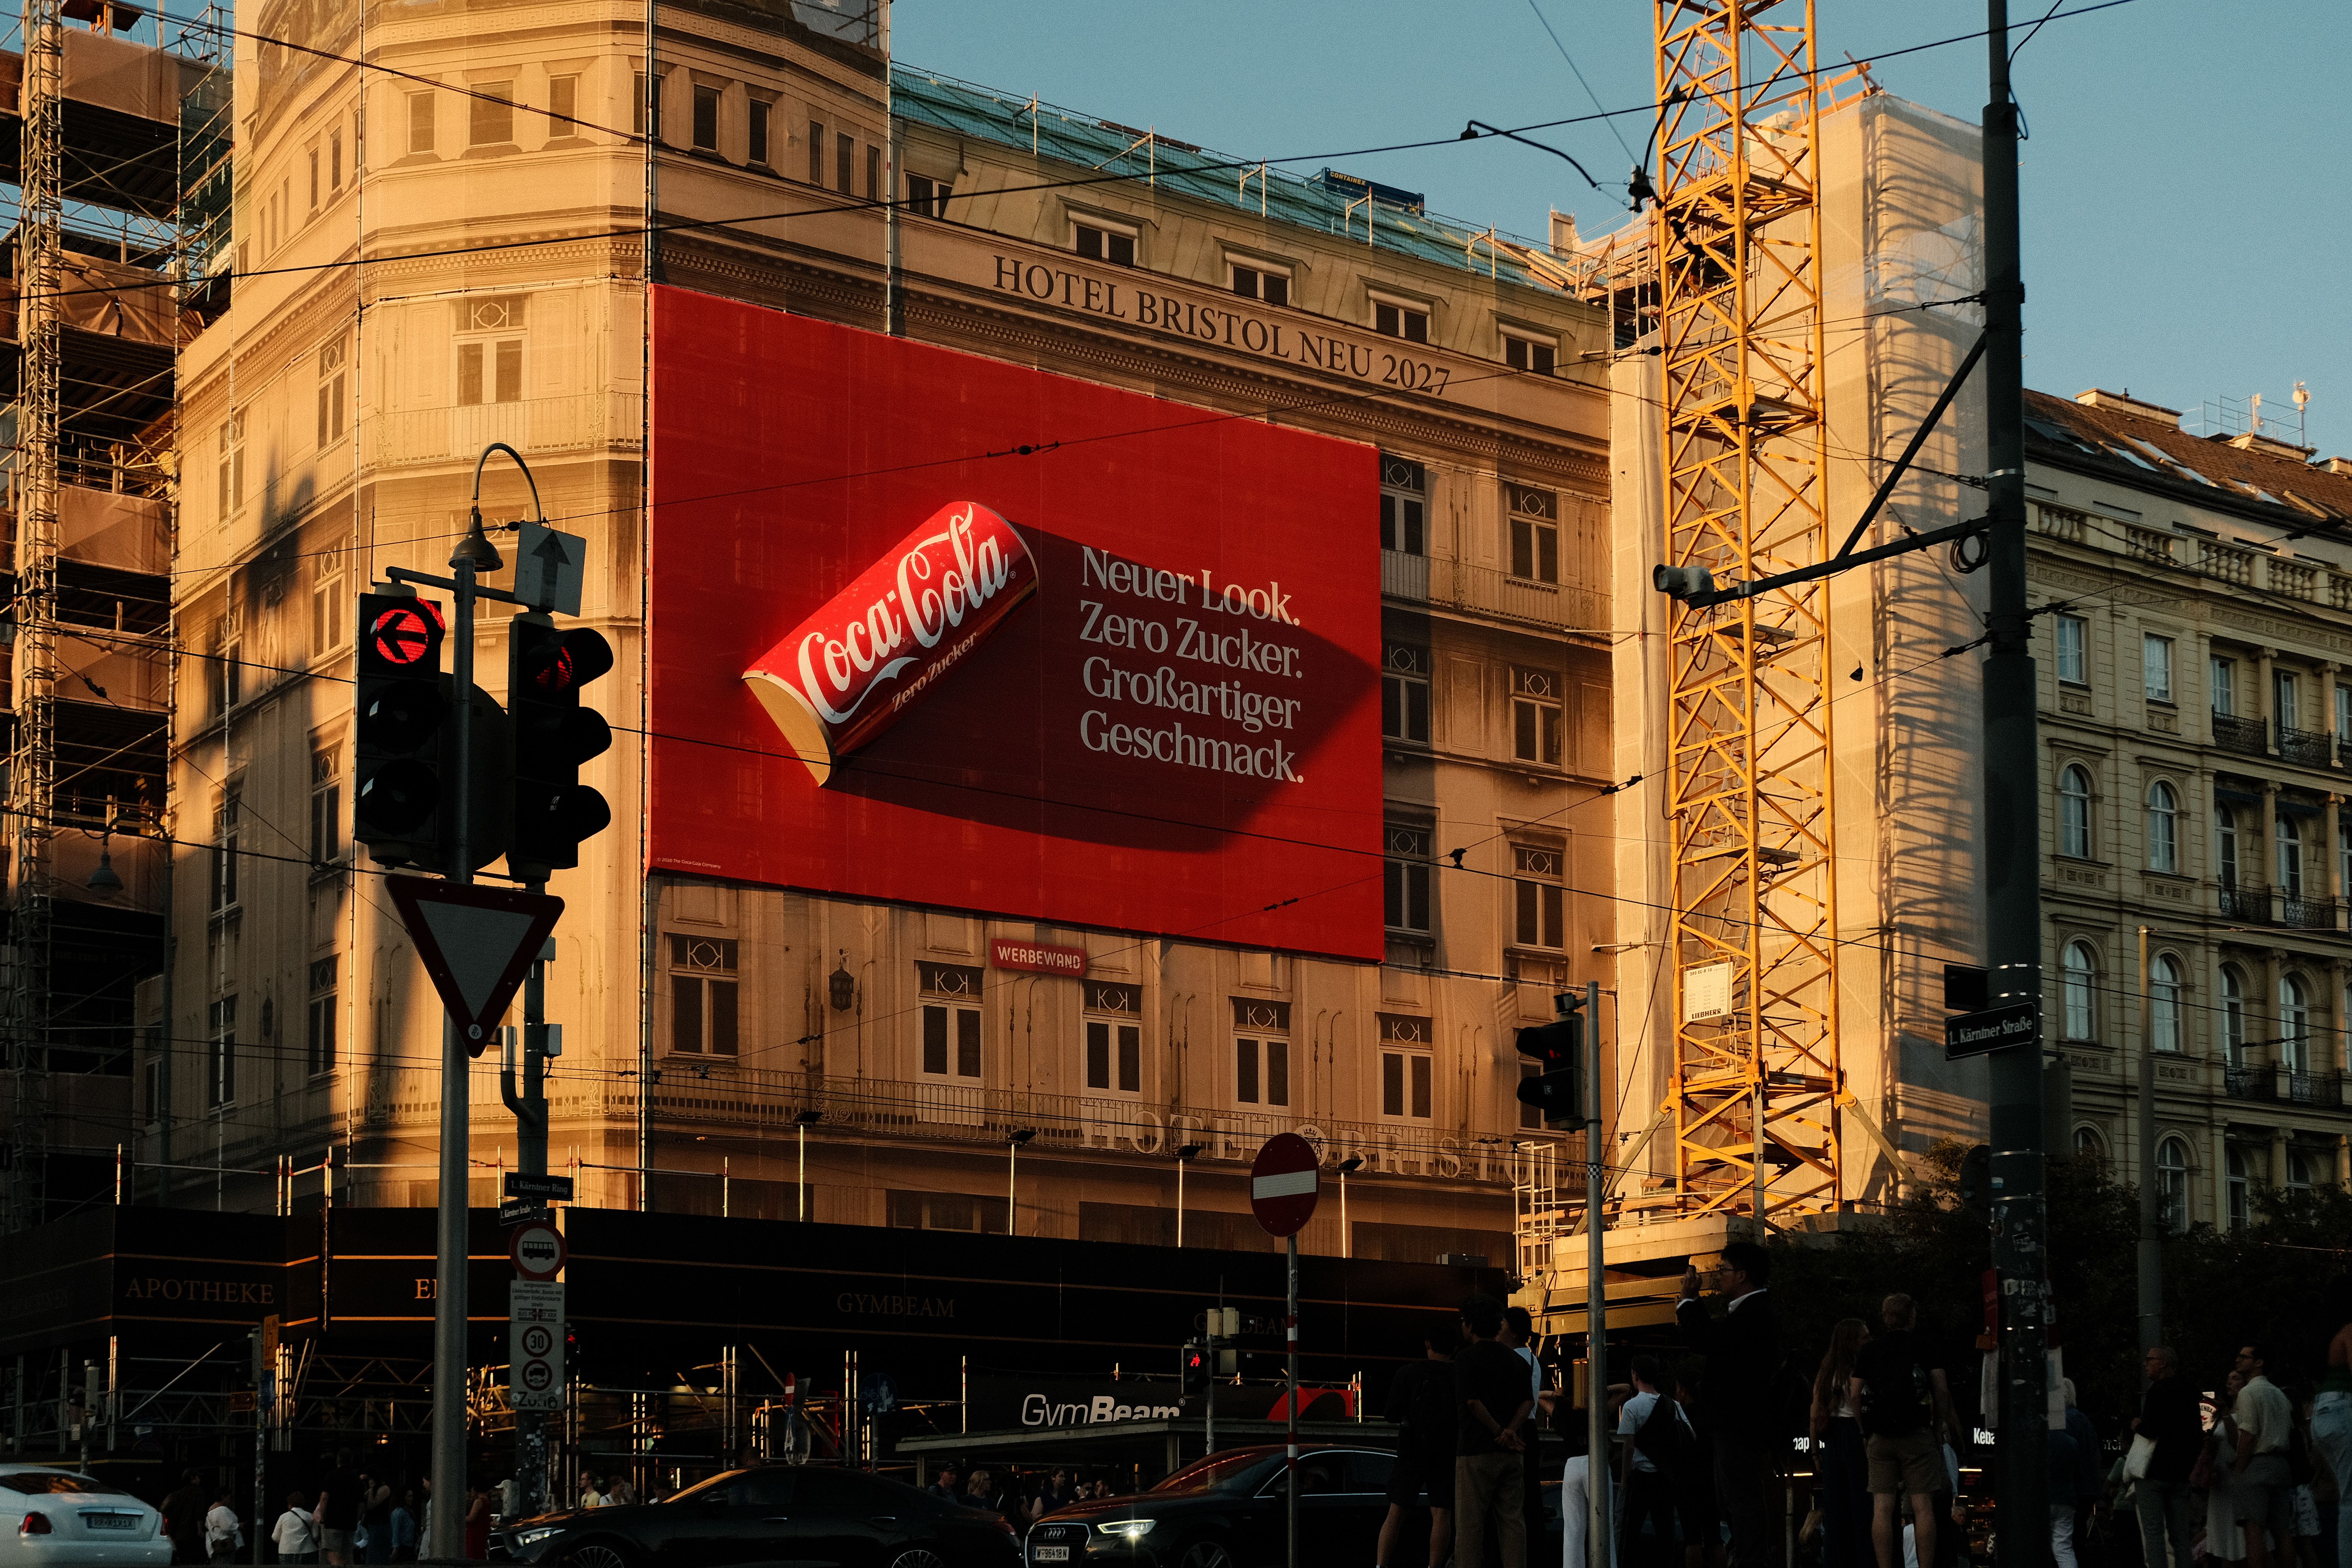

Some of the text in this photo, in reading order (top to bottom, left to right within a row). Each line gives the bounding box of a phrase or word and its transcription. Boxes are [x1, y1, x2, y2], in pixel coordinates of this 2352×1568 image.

[993, 254, 1451, 396] HOTEL BRISTOL NEU 2027
[1082, 545, 1300, 626] Neuer Look.
[1080, 599, 1302, 678] Zero Zucker.
[892, 630, 979, 713] Zero Zucker
[1083, 656, 1301, 733] Großartiger
[1080, 710, 1304, 784] Geschmack.
[997, 946, 1080, 969] WERBEWAND
[1692, 1008, 1721, 1019] LIEBHERR
[1960, 1024, 2000, 1043] Kärntner
[2002, 1016, 2032, 1035] Straße
[519, 1180, 550, 1191] Kärntner
[552, 1183, 568, 1195] Ring
[125, 1277, 275, 1304] APOTHEKE
[836, 1292, 956, 1318] GYMBEAM
[530, 1335, 544, 1349] 30
